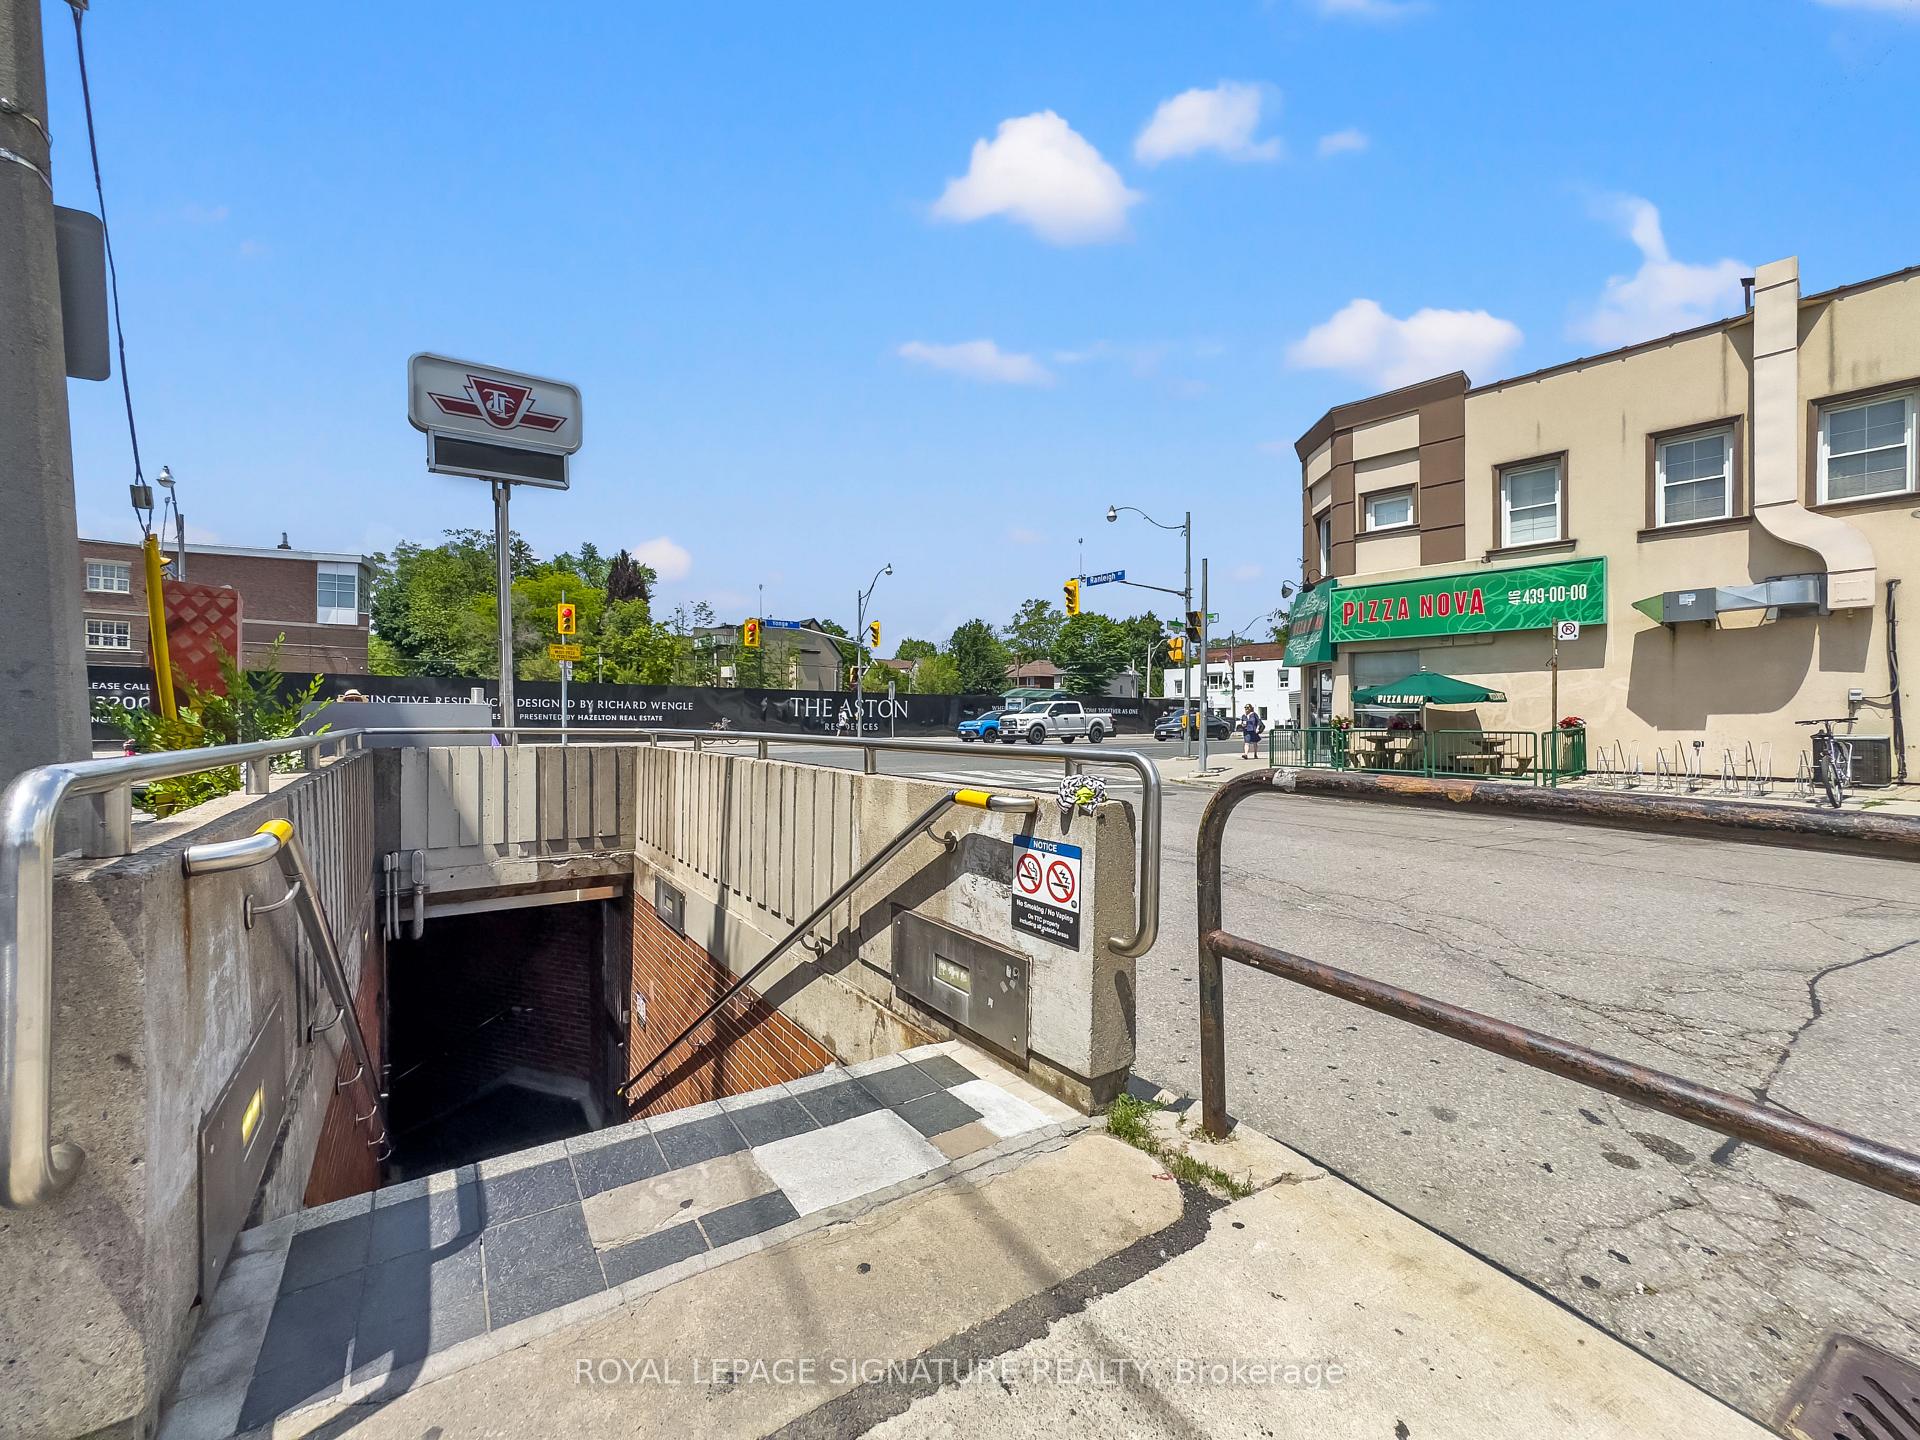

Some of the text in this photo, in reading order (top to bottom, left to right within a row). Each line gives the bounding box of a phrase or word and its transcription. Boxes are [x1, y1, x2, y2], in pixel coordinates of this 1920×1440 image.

[1090, 572, 1116, 584] Ranleigh
[1508, 583, 1587, 605] 416 439-00-00
[1342, 597, 1410, 626] PIZZA
[1419, 588, 1485, 619] NOVA
[88, 682, 150, 691] EASE CALL
[517, 698, 575, 708] DESIGND
[580, 700, 593, 709] BY
[597, 700, 647, 710] RICHARD
[651, 701, 694, 711] WENGLE
[1377, 695, 1424, 704] PIZZA NOVA
[790, 697, 908, 719] THE ASTON
[519, 713, 562, 721] PRESENTED
[825, 722, 879, 731] RESDECES
[1033, 841, 1057, 852] NOTICE
[1016, 899, 1023, 907] No
[1023, 901, 1044, 915] Smoking
[1047, 908, 1055, 917] No
[1056, 911, 1073, 923] Vaping
[1034, 914, 1043, 922] TTC
[1042, 918, 1060, 929] property
